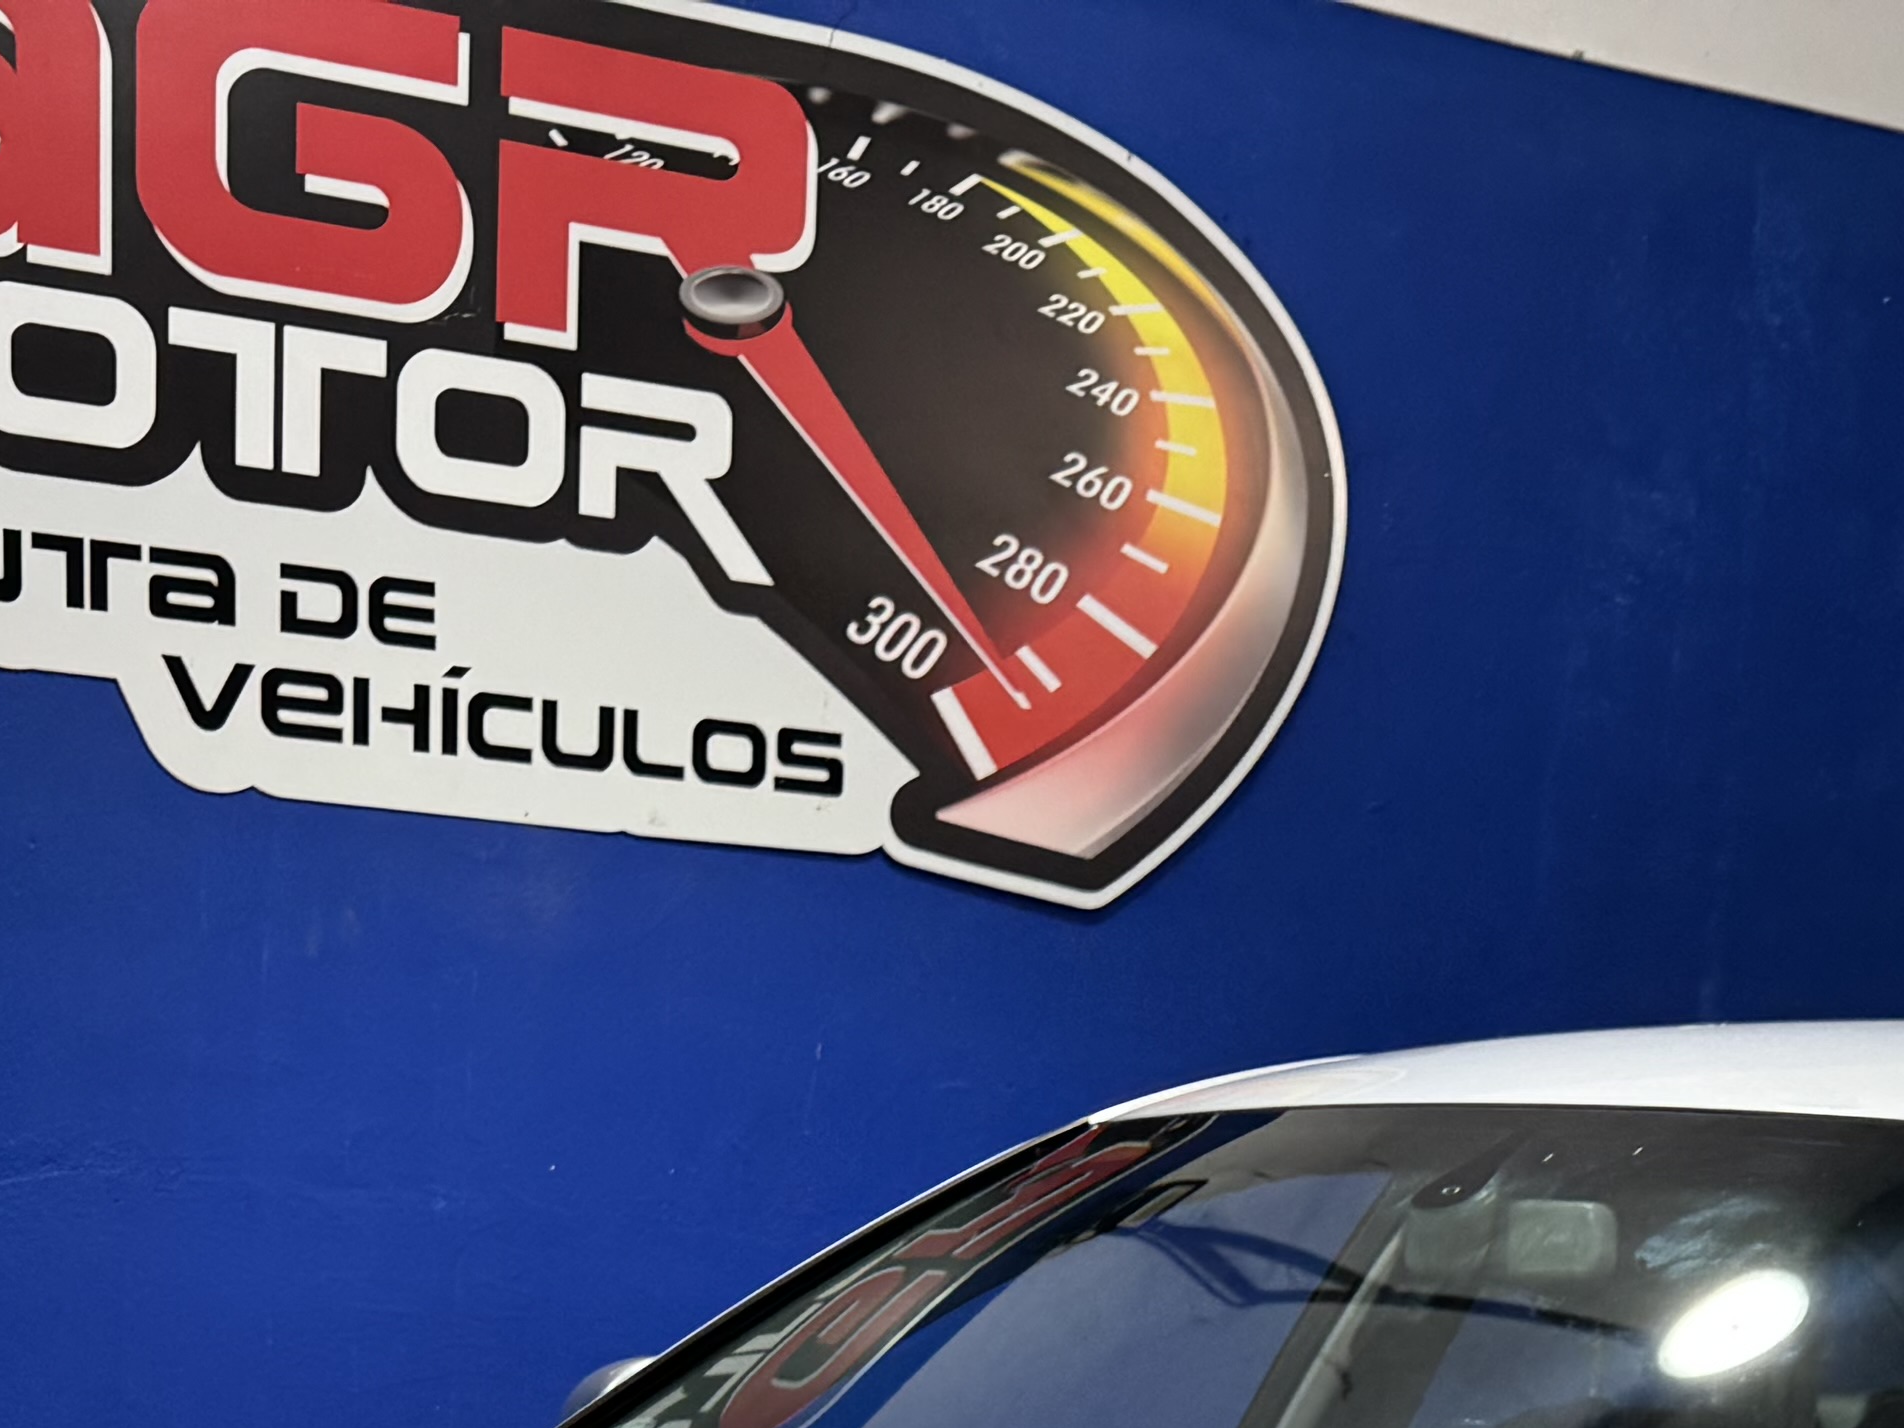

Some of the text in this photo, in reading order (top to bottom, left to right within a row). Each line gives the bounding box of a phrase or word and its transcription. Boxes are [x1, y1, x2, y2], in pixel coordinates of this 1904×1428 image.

[818, 157, 871, 189] 160
[908, 188, 964, 221] 180
[982, 233, 1046, 271] 200
[1038, 293, 1105, 335] 220
[1065, 368, 1139, 417] 240
[1049, 452, 1132, 512] 260
[976, 534, 1070, 605] 280
[279, 561, 437, 650] DE
[846, 596, 948, 680] 300
